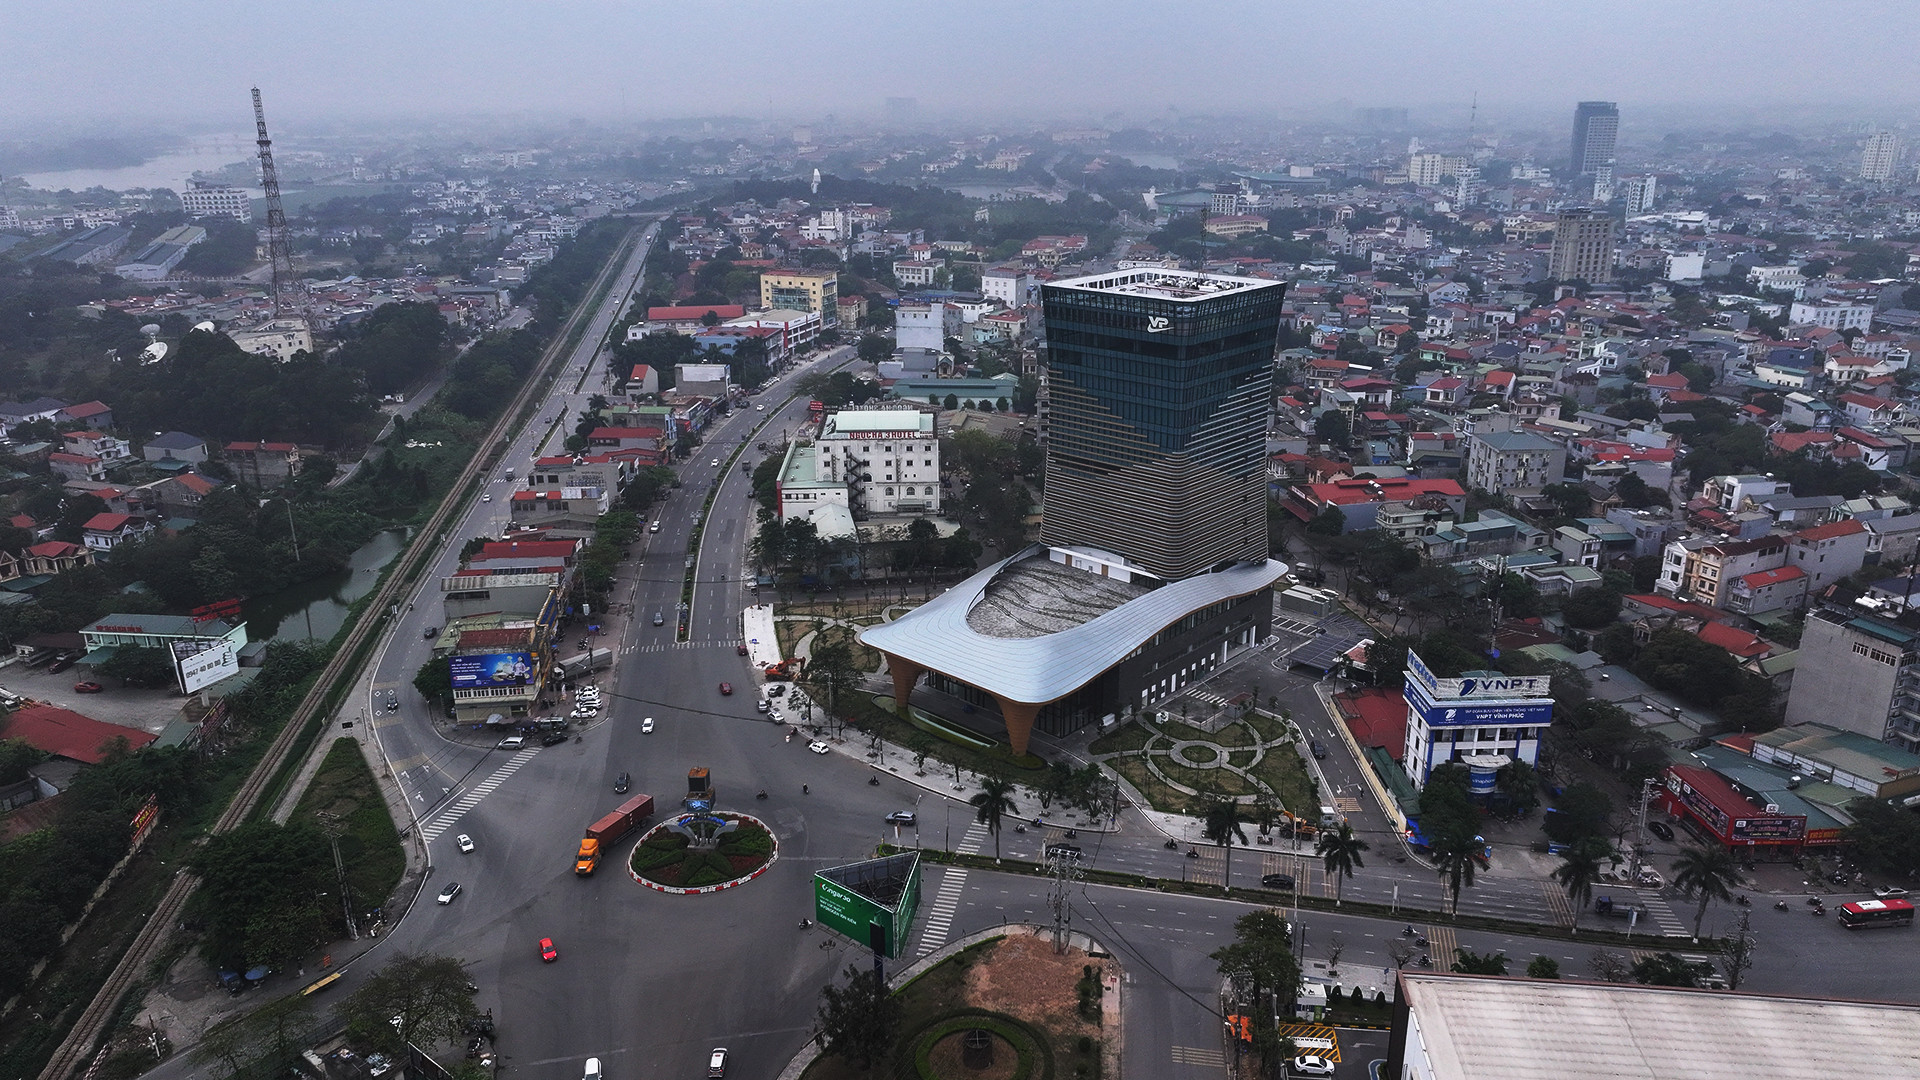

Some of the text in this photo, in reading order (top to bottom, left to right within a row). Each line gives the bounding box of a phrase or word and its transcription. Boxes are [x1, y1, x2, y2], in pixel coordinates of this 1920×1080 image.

[1148, 316, 1168, 328] VP
[1481, 679, 1537, 690] VNPT
[1508, 711, 1525, 719] PHÚC
